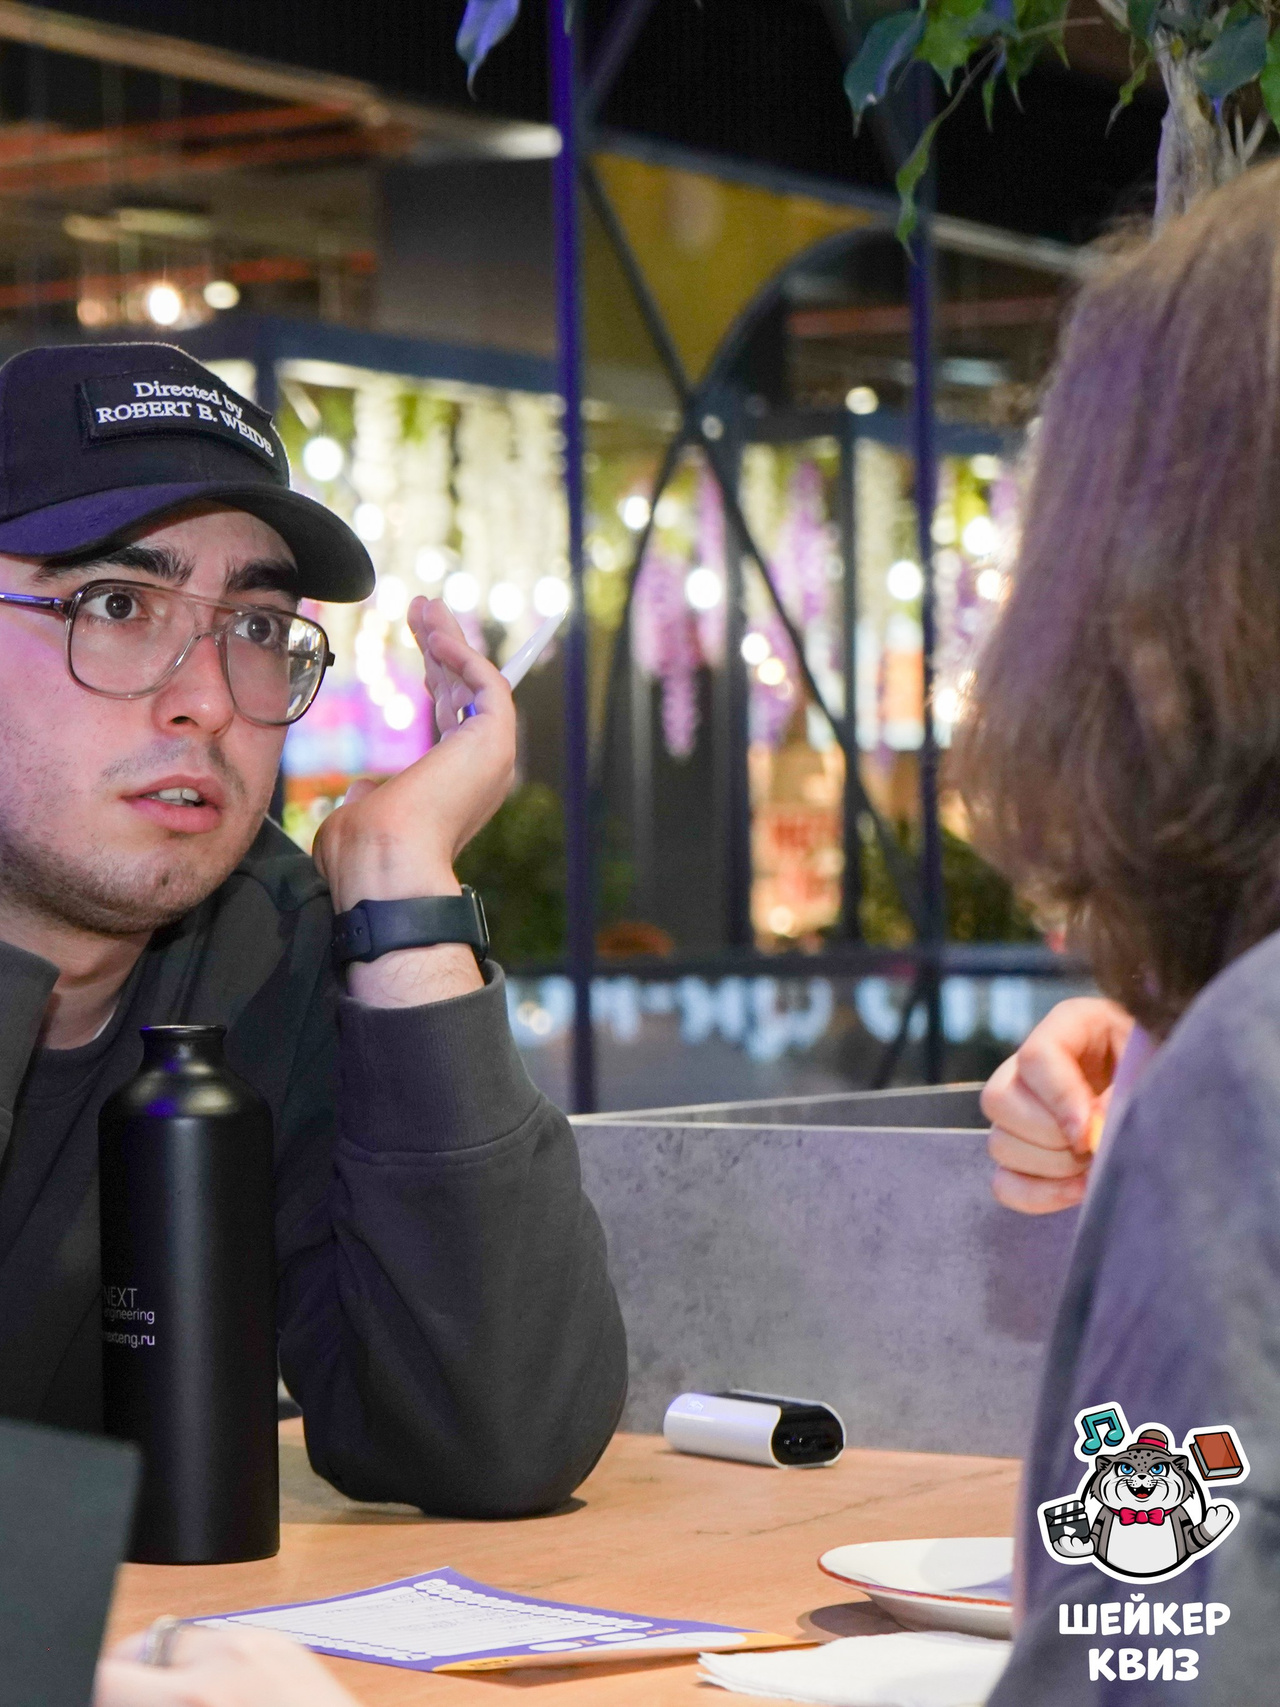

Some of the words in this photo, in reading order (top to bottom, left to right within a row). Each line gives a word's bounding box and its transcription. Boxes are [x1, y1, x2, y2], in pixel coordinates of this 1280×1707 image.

[133, 380, 222, 406] Directed
[223, 394, 243, 419] by
[96, 401, 191, 424] ROBERT
[197, 403, 219, 422] B.
[220, 410, 274, 458] WEIDE
